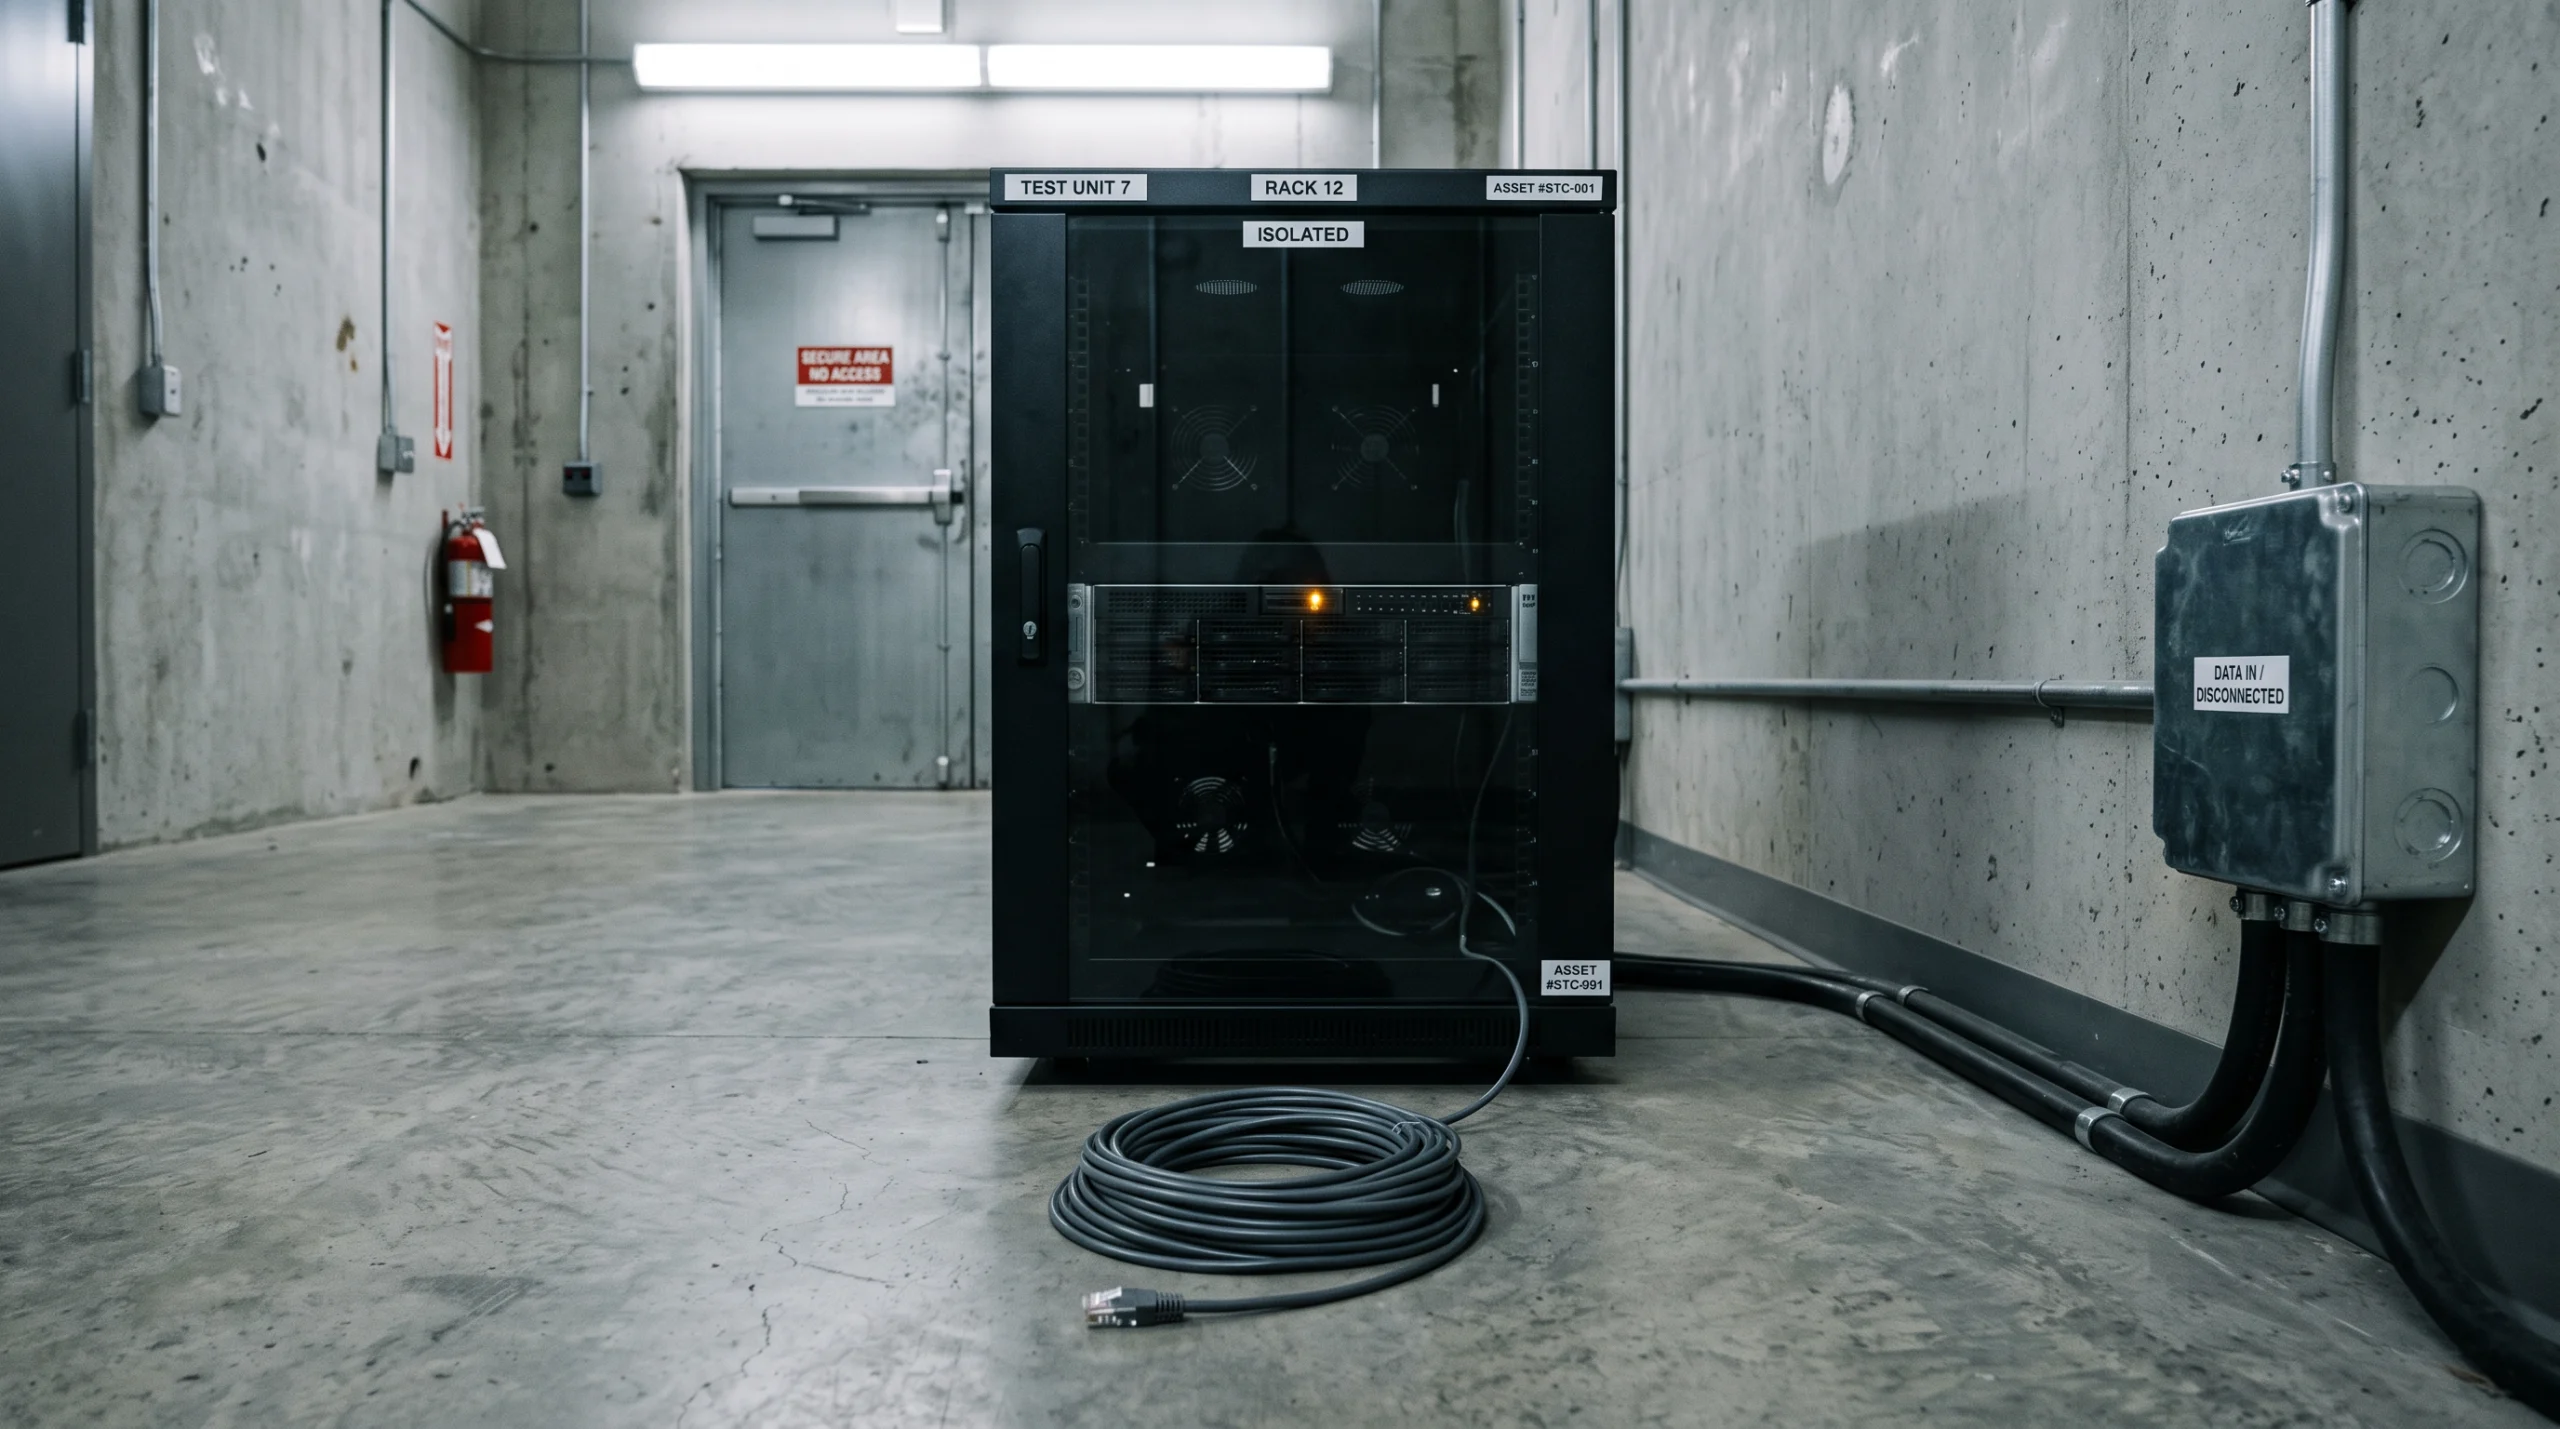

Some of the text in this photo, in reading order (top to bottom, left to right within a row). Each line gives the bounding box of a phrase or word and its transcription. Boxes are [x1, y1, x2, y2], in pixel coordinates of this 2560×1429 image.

[1020, 180, 1131, 195] TEST UNIT 7
[1265, 180, 1344, 195] RACK 12
[1493, 182, 1595, 194] ASSET #STC-001
[1257, 226, 1349, 243] ISOLATED
[801, 349, 890, 365] SECURE AREA
[808, 366, 881, 382] NO ACCESS
[2214, 664, 2265, 680] DATA IN /
[2196, 686, 2285, 704] DISCONNECTED
[1554, 964, 1597, 976] ASSET
[1546, 979, 1603, 990] #STC-991
